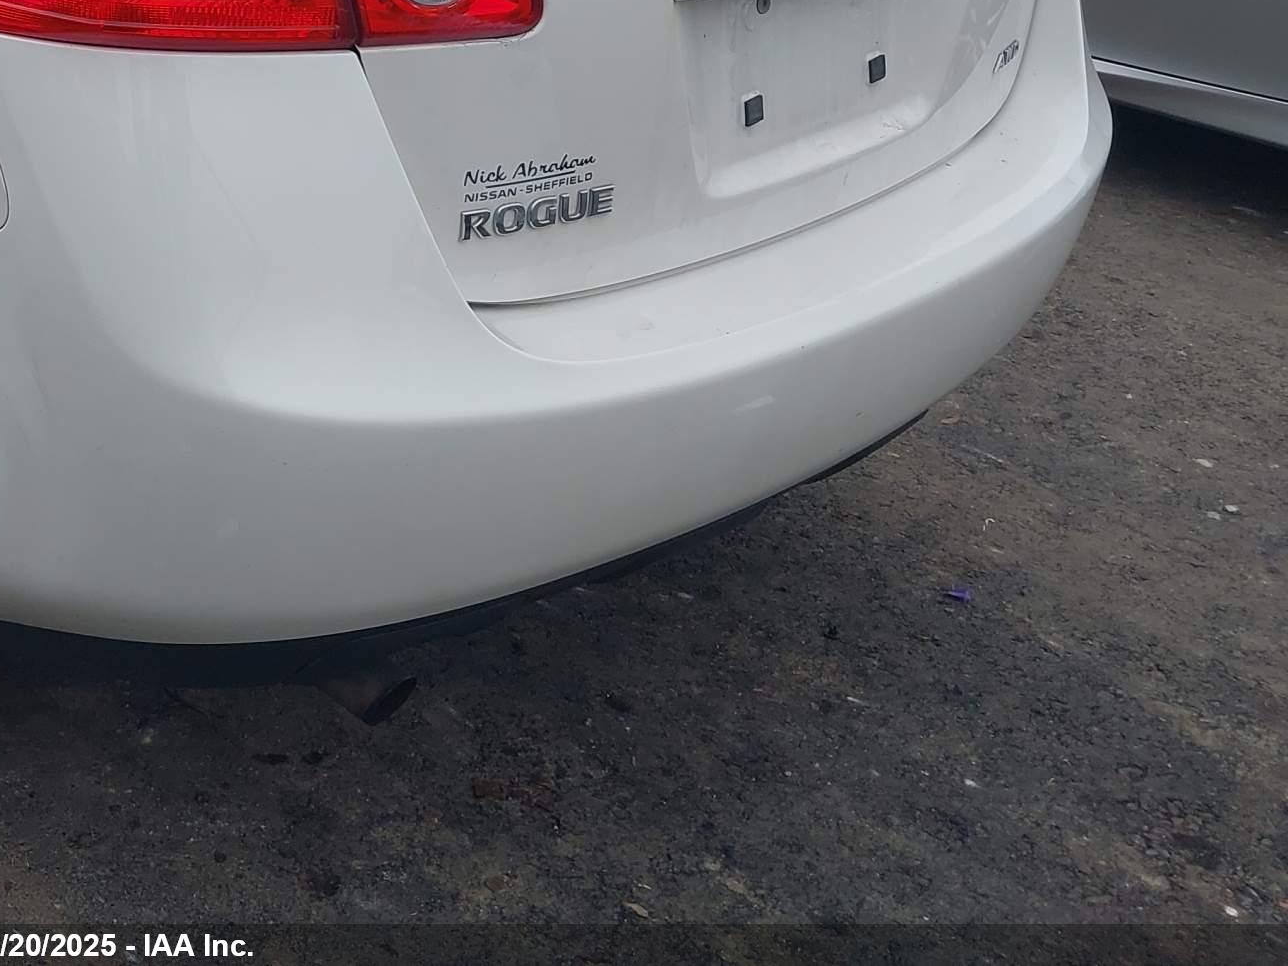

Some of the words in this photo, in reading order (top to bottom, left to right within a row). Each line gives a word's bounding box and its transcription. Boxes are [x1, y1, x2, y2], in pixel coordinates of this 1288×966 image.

[463, 164, 508, 187] Nick
[512, 153, 596, 181] Abraham
[458, 184, 616, 242] ROGUE
